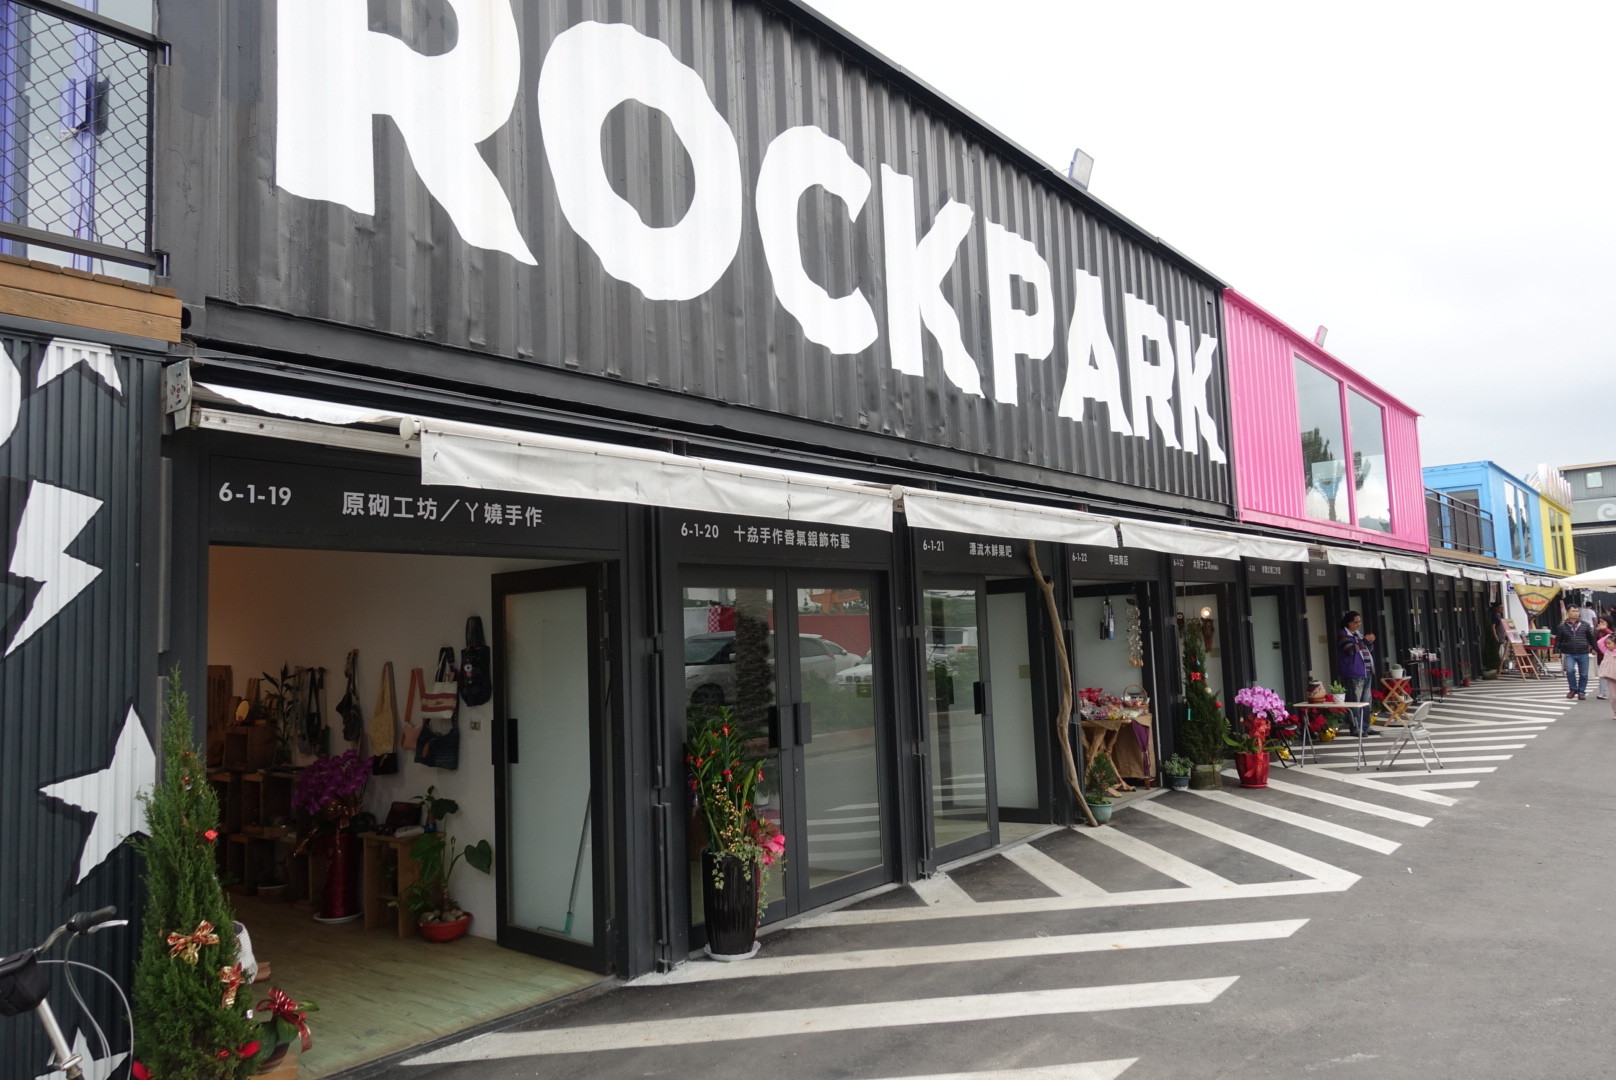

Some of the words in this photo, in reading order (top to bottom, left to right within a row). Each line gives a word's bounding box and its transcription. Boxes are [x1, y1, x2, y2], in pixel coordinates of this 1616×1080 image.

[218, 482, 292, 506] 6-1-19
[680, 522, 719, 539] 6-1-20
[922, 539, 945, 552] 6-1-21
